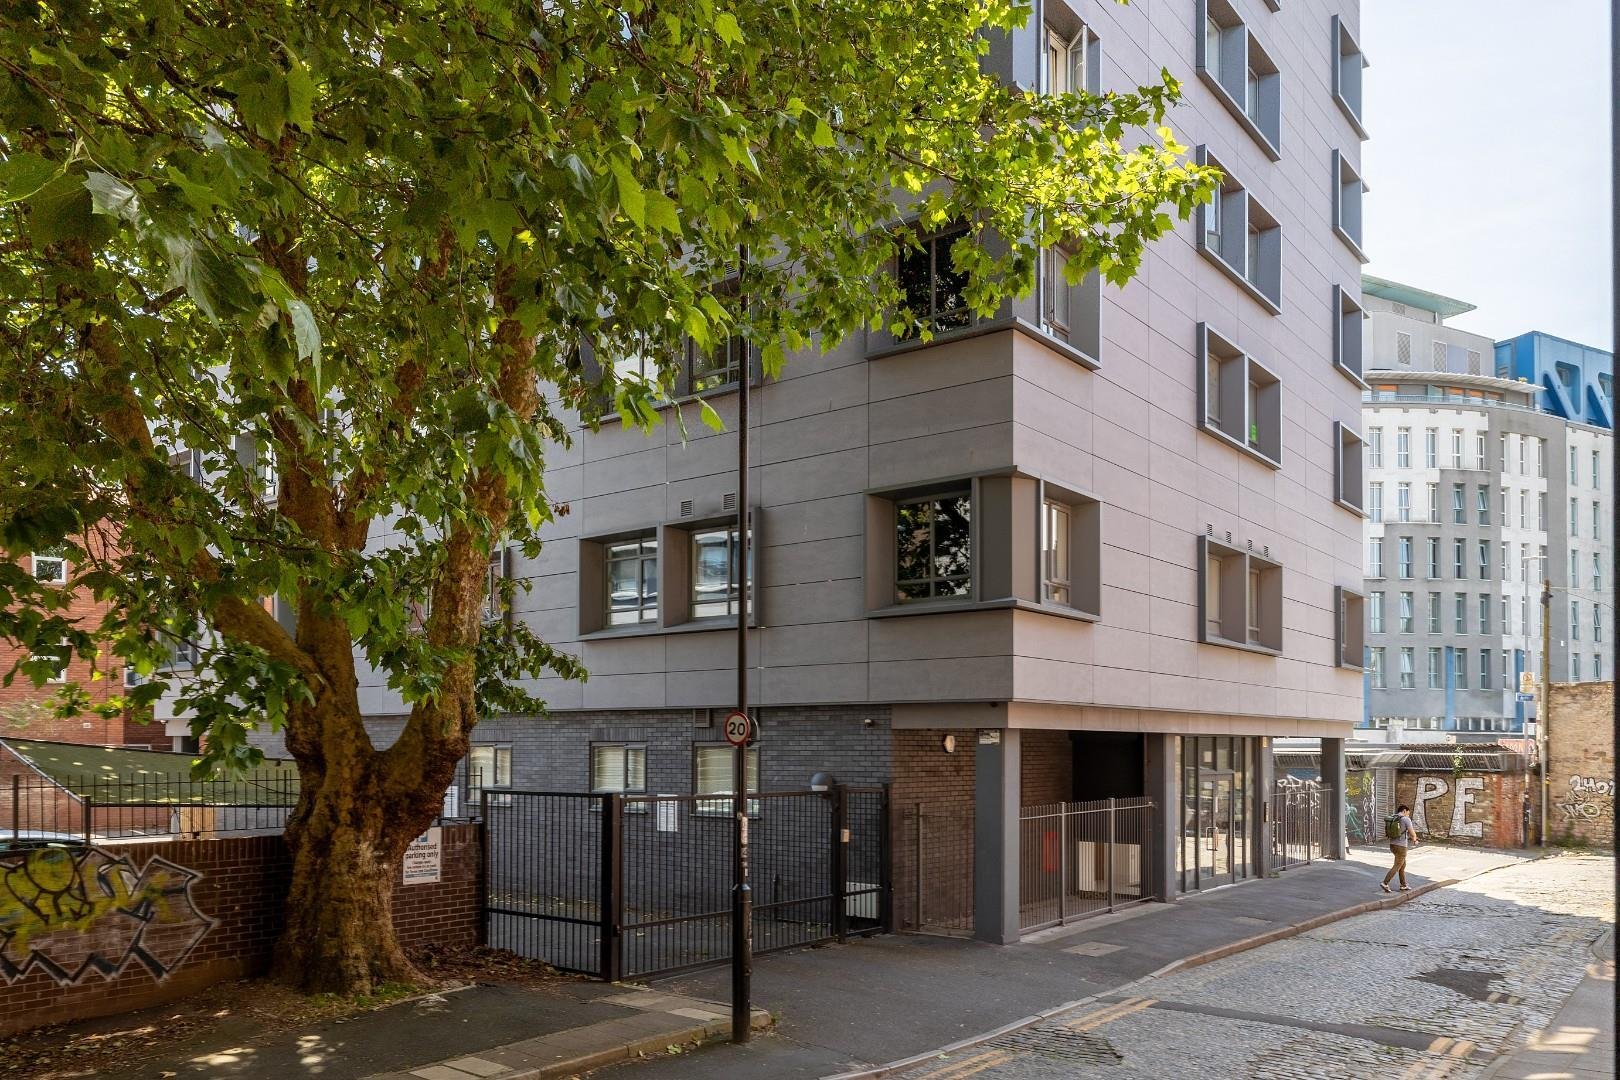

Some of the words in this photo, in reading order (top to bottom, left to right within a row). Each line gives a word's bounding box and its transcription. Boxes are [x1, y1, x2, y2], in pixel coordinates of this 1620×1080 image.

[728, 721, 746, 736] 20
[1411, 775, 1484, 838] PE
[405, 851, 426, 860] parking
[427, 850, 439, 859] only
